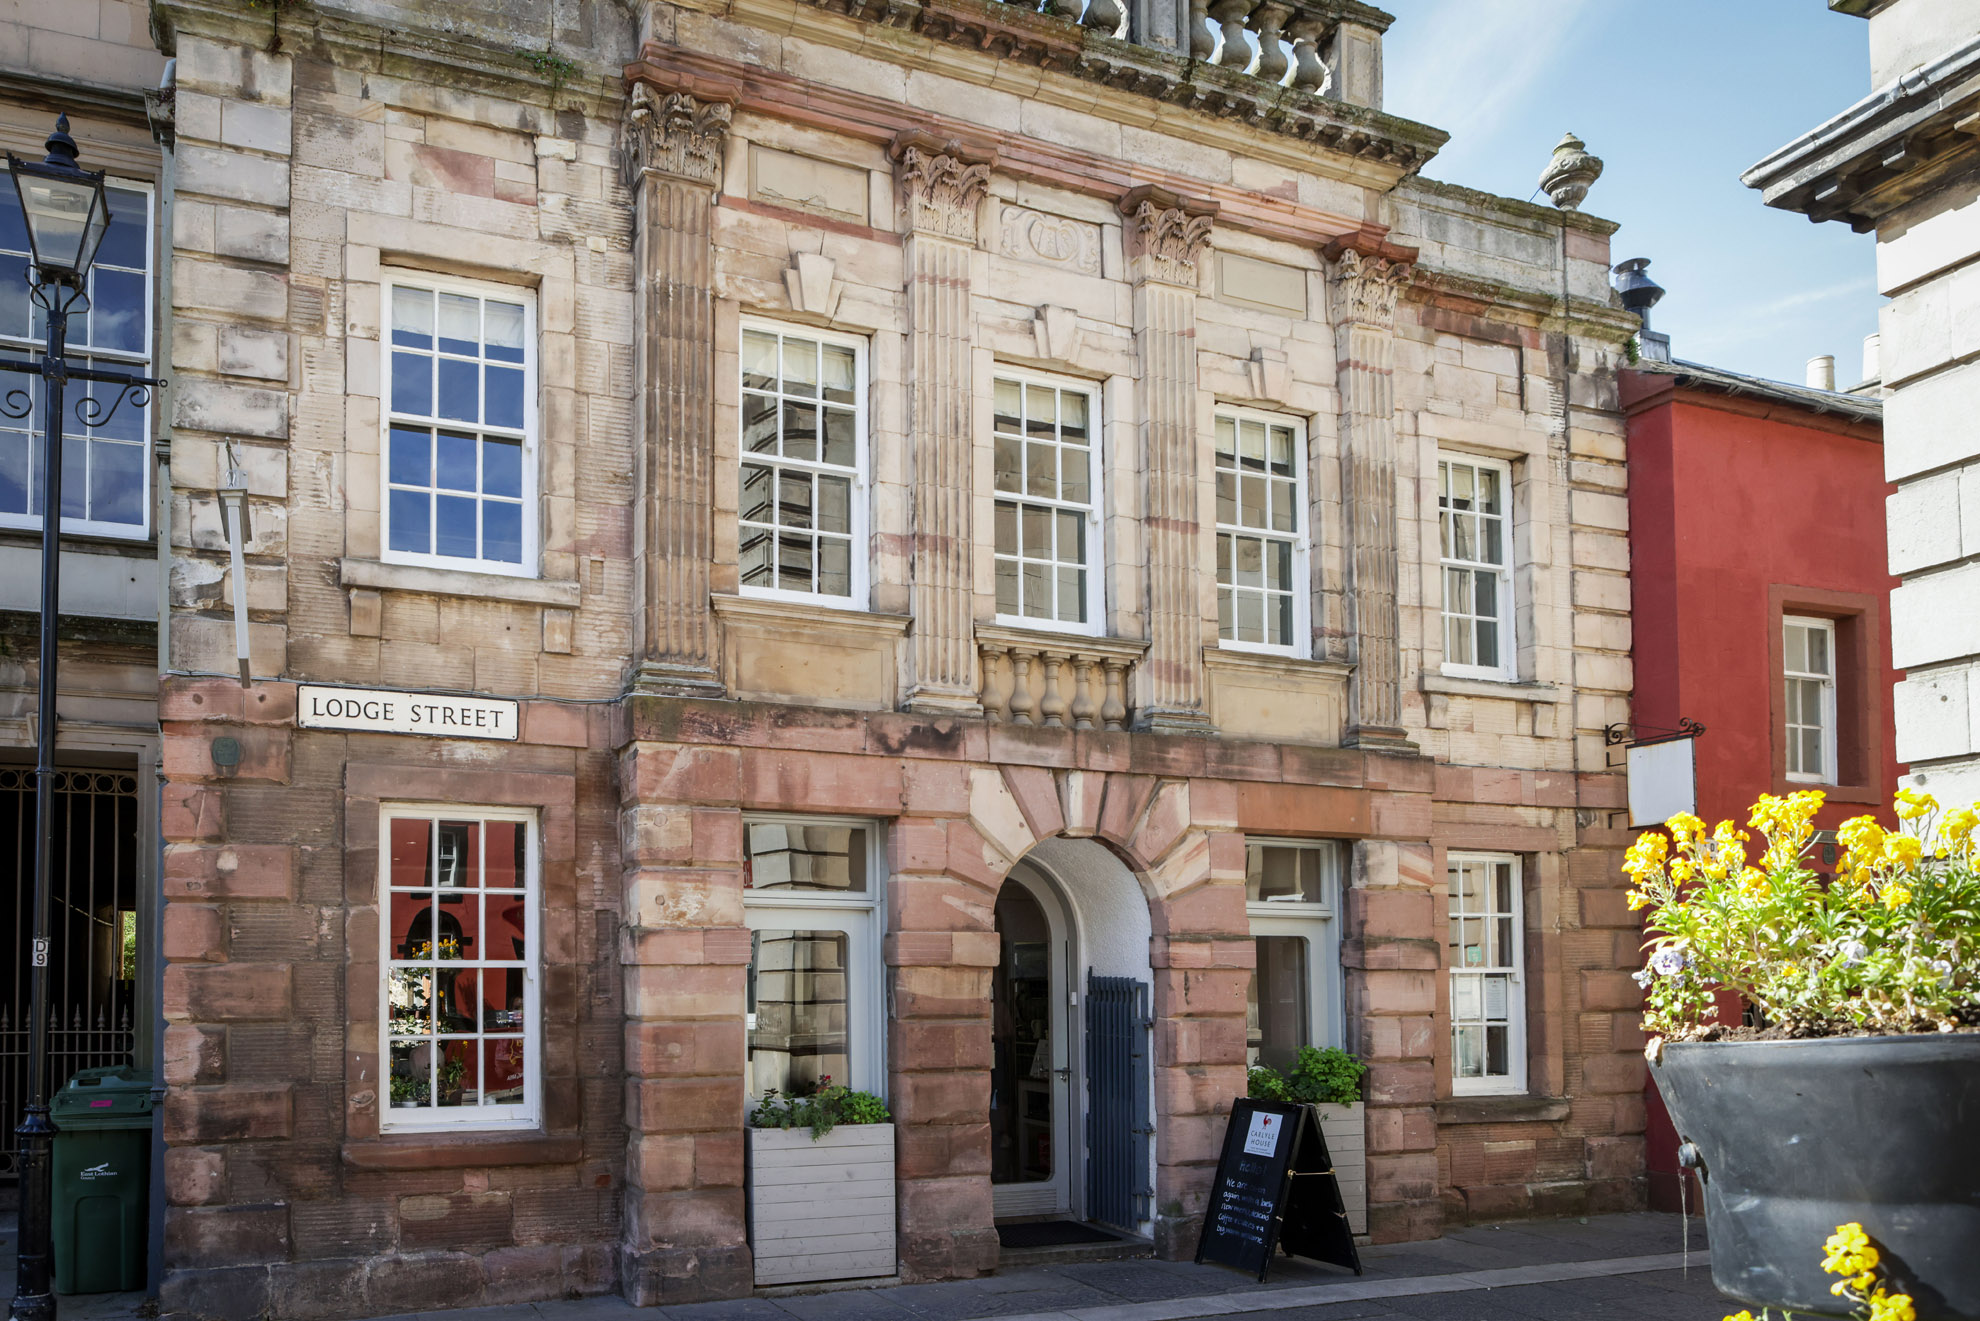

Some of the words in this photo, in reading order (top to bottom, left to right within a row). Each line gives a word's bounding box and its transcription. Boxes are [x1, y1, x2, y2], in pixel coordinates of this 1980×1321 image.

[312, 697, 395, 721] LODGE
[410, 704, 504, 728] STREET
[36, 940, 46, 952] D
[36, 953, 45, 965] 9
[1250, 1130, 1275, 1140] CARLYLE
[1250, 1138, 1272, 1148] HOUSE
[1226, 1176, 1236, 1187] We
